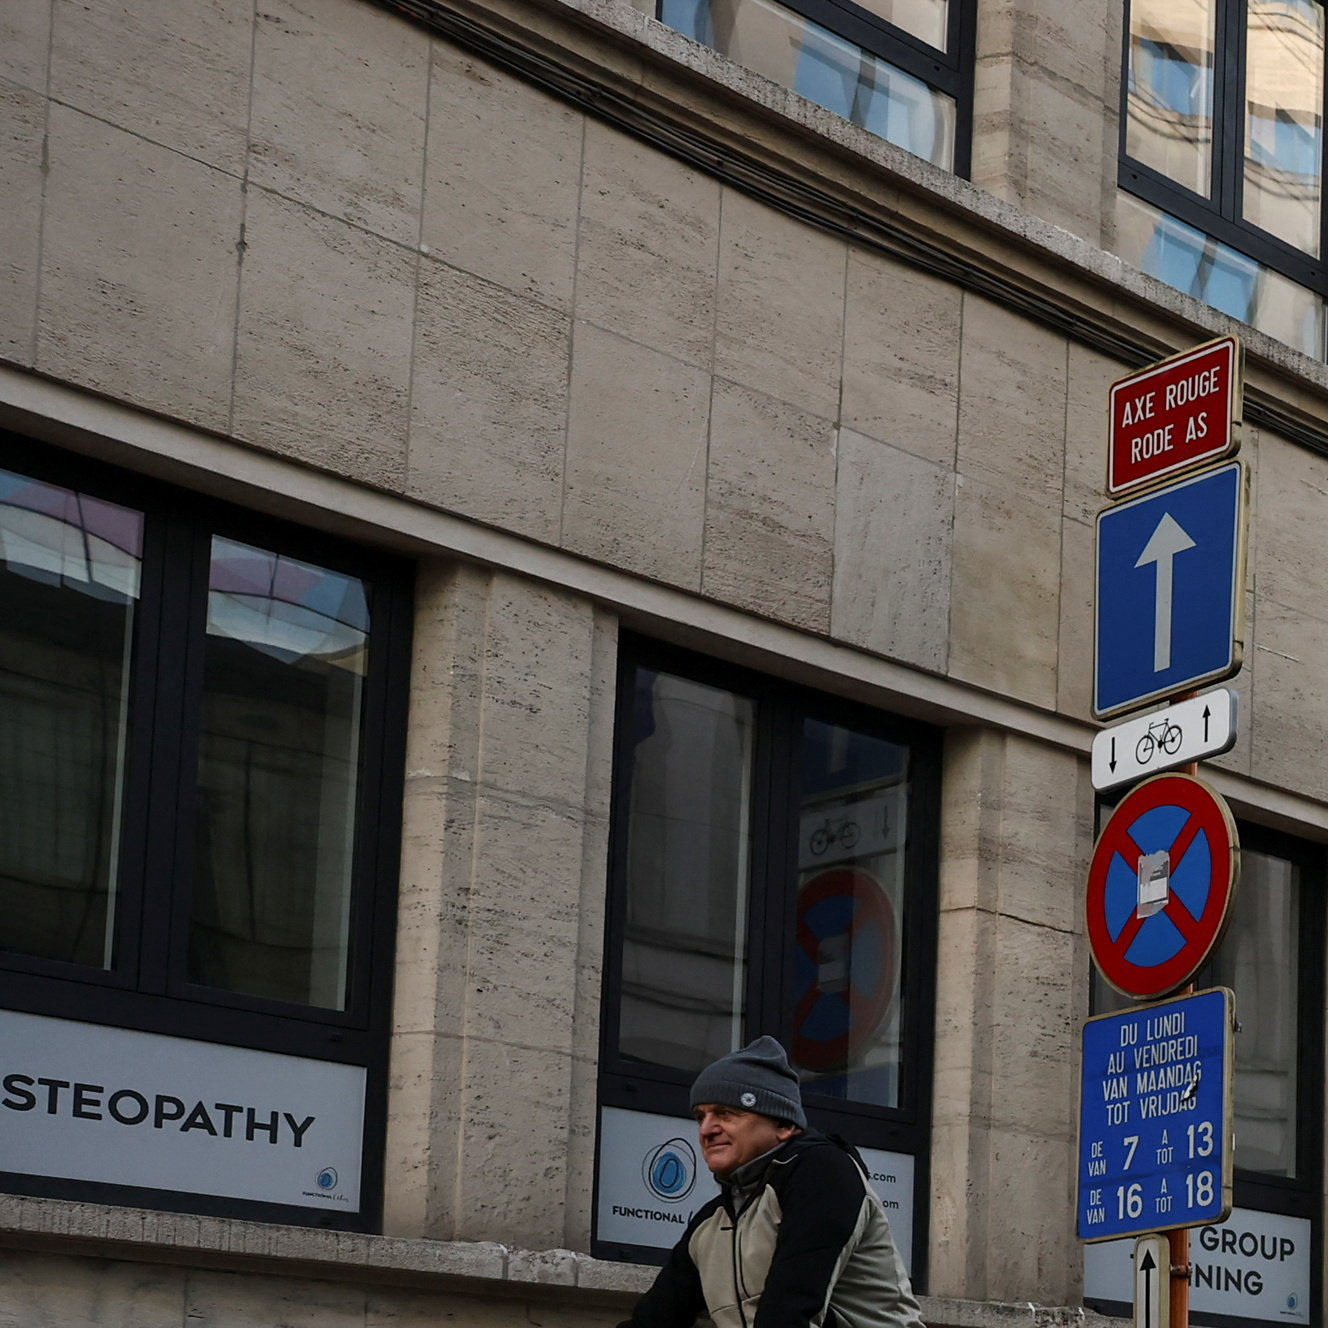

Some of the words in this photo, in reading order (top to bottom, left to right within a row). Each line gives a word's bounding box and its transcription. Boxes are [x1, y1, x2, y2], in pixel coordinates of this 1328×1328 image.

[1122, 391, 1156, 428] AXE
[1165, 366, 1220, 411] ROUGE
[1131, 424, 1174, 464] RODE
[1185, 411, 1208, 444] AS
[1120, 1022, 1138, 1047] DU
[1146, 1011, 1185, 1041] LUNDI
[1107, 1053, 1125, 1076] AU
[1134, 1035, 1199, 1070] VENDREDI
[1102, 1075, 1128, 1102] VAN
[1136, 1060, 1202, 1096] MAANDAG
[1, 1073, 316, 1149] STEOPATHY
[1106, 1101, 1131, 1127] TOT
[1140, 1090, 1197, 1120] VRIJDAG
[1091, 1141, 1104, 1159] DE
[1123, 1135, 1140, 1171] 7
[1186, 1121, 1215, 1160] 13
[1161, 1129, 1170, 1146] A
[1088, 1159, 1107, 1178] VAN
[1156, 1146, 1175, 1166] TOT
[1090, 1188, 1103, 1207] DE
[1116, 1183, 1144, 1221] 16
[1185, 1170, 1214, 1210] 18
[1160, 1177, 1168, 1195] A
[612, 1205, 685, 1225] FUNCTIONAL
[1086, 1207, 1106, 1226] VAN
[1155, 1195, 1173, 1215] TOT
[1199, 1226, 1296, 1263] GROUP
